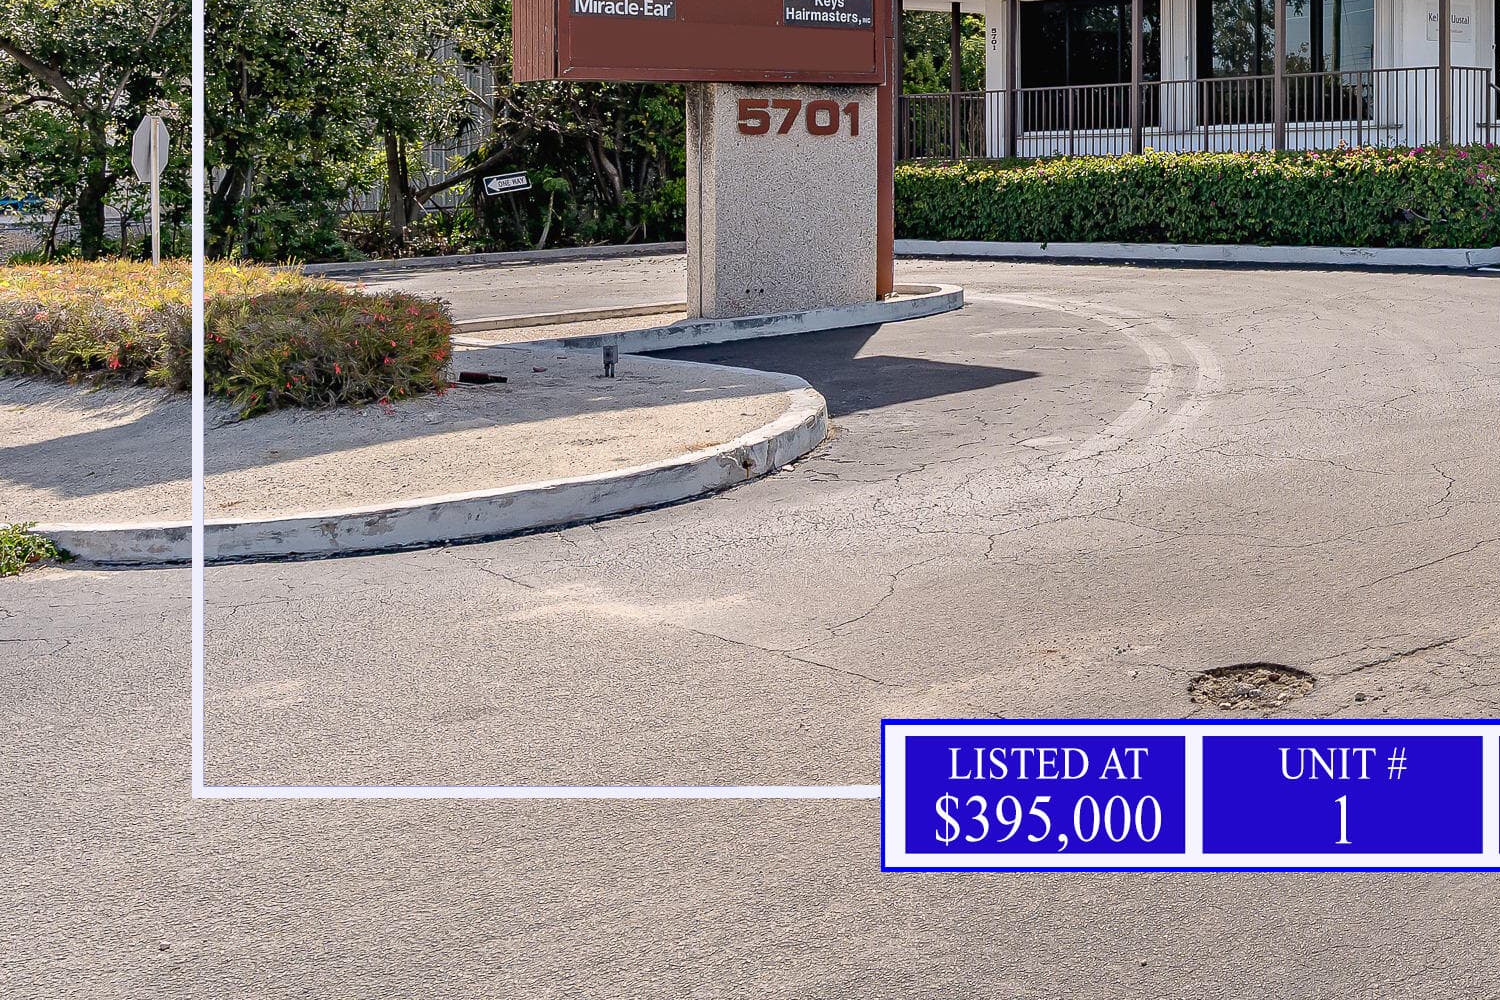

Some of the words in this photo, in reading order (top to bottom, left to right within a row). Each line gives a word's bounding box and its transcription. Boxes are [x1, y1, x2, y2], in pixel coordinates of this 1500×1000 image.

[786, 7, 861, 25] Hairmasters,
[738, 99, 861, 137] 5701
[498, 179, 511, 188] ONE
[511, 176, 525, 185] WAY
